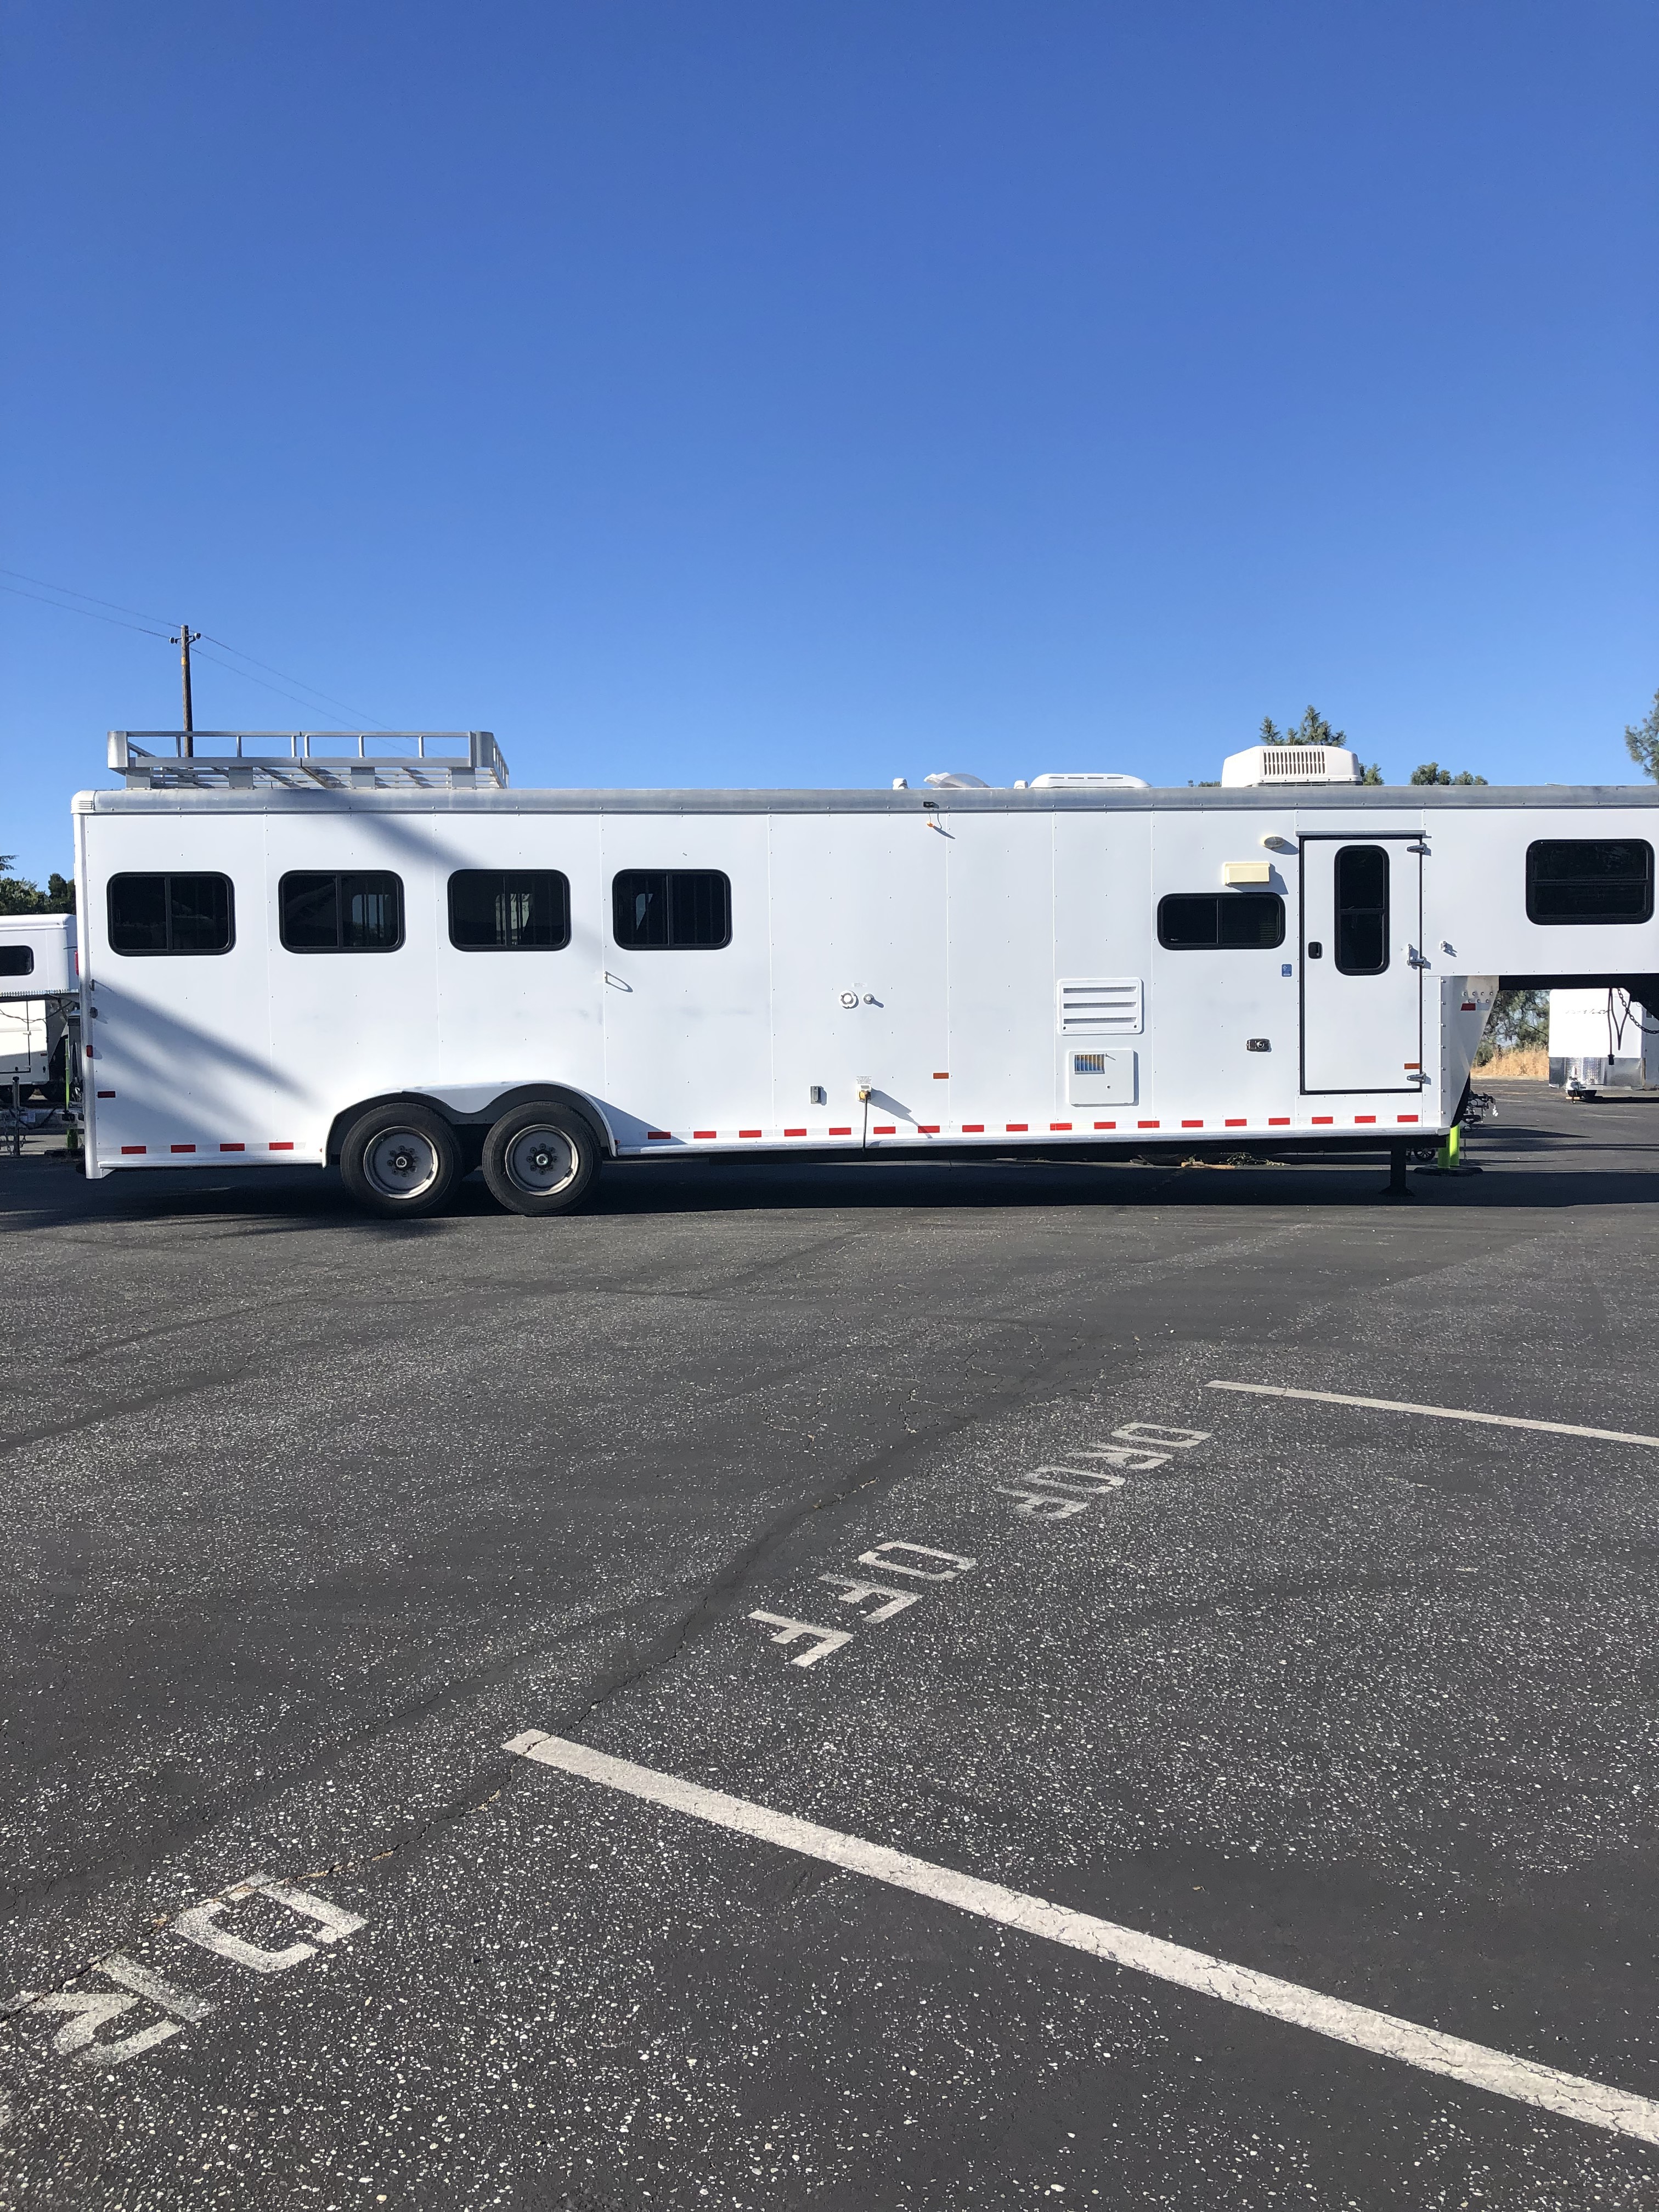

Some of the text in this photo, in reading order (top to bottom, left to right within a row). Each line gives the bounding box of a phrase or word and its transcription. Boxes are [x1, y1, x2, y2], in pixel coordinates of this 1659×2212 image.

[747, 1423, 1212, 1667] DROP OFF
[0, 1872, 369, 2128] DR
